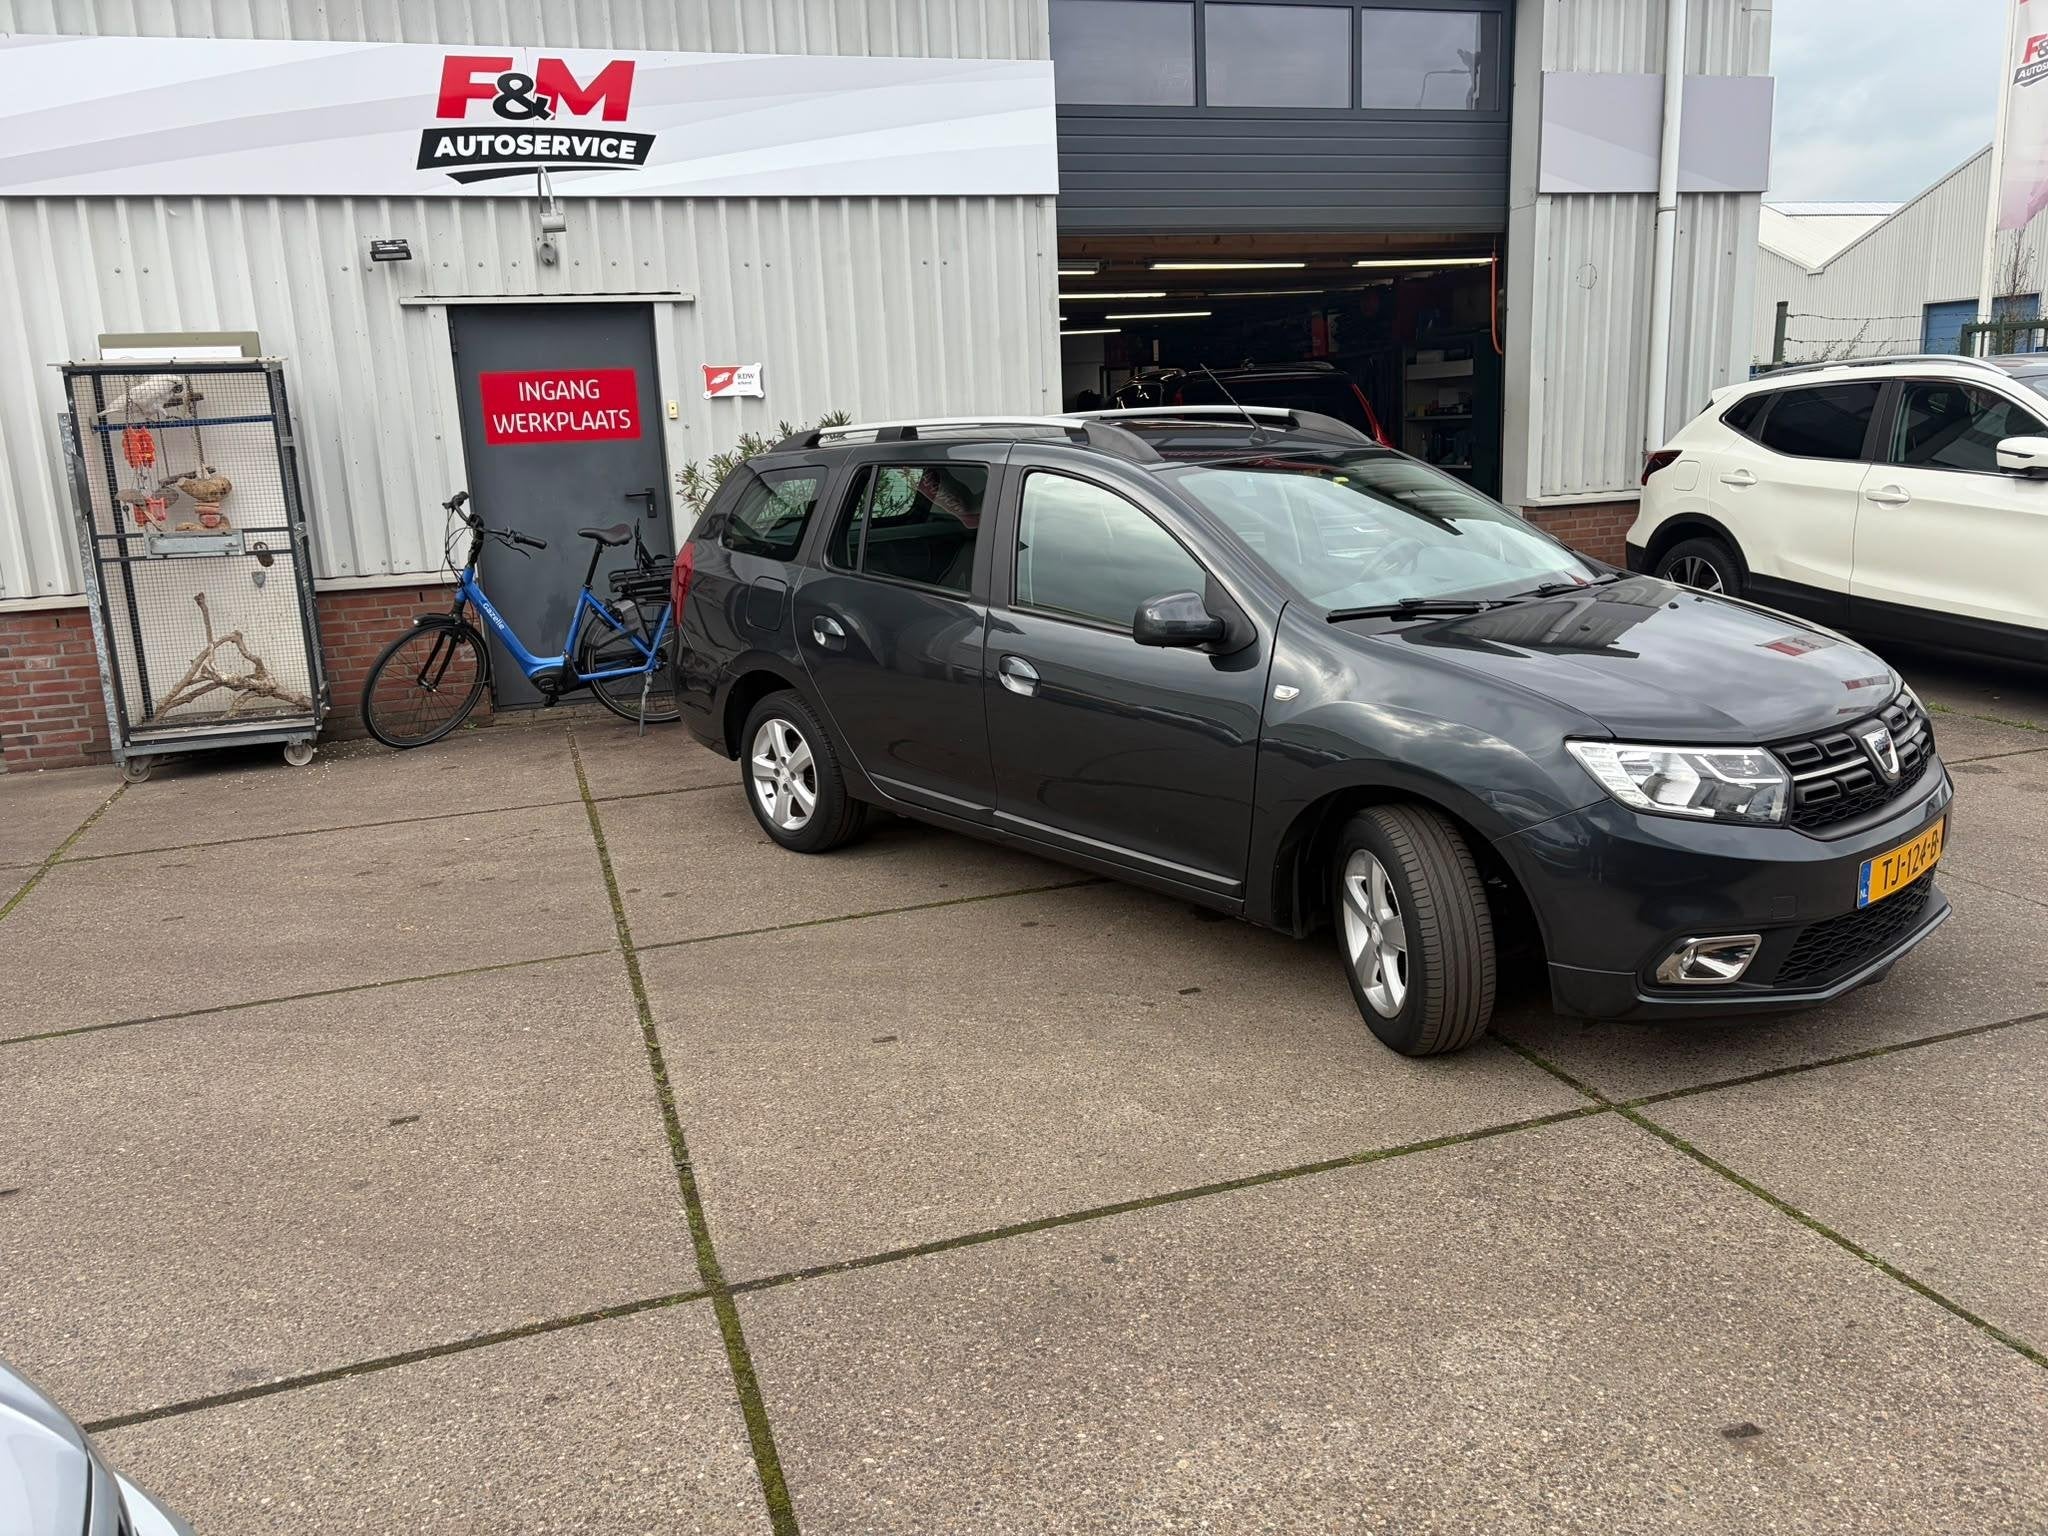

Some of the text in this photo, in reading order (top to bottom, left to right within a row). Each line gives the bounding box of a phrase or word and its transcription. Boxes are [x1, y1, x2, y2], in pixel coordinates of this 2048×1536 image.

[2018, 61, 2048, 80] AUTOS
[436, 55, 636, 121] F&M
[434, 134, 637, 160] AUTOSERVICE
[518, 379, 600, 402] INGANG
[492, 409, 632, 434] WERKPLAATS
[482, 602, 505, 630] Gazelle
